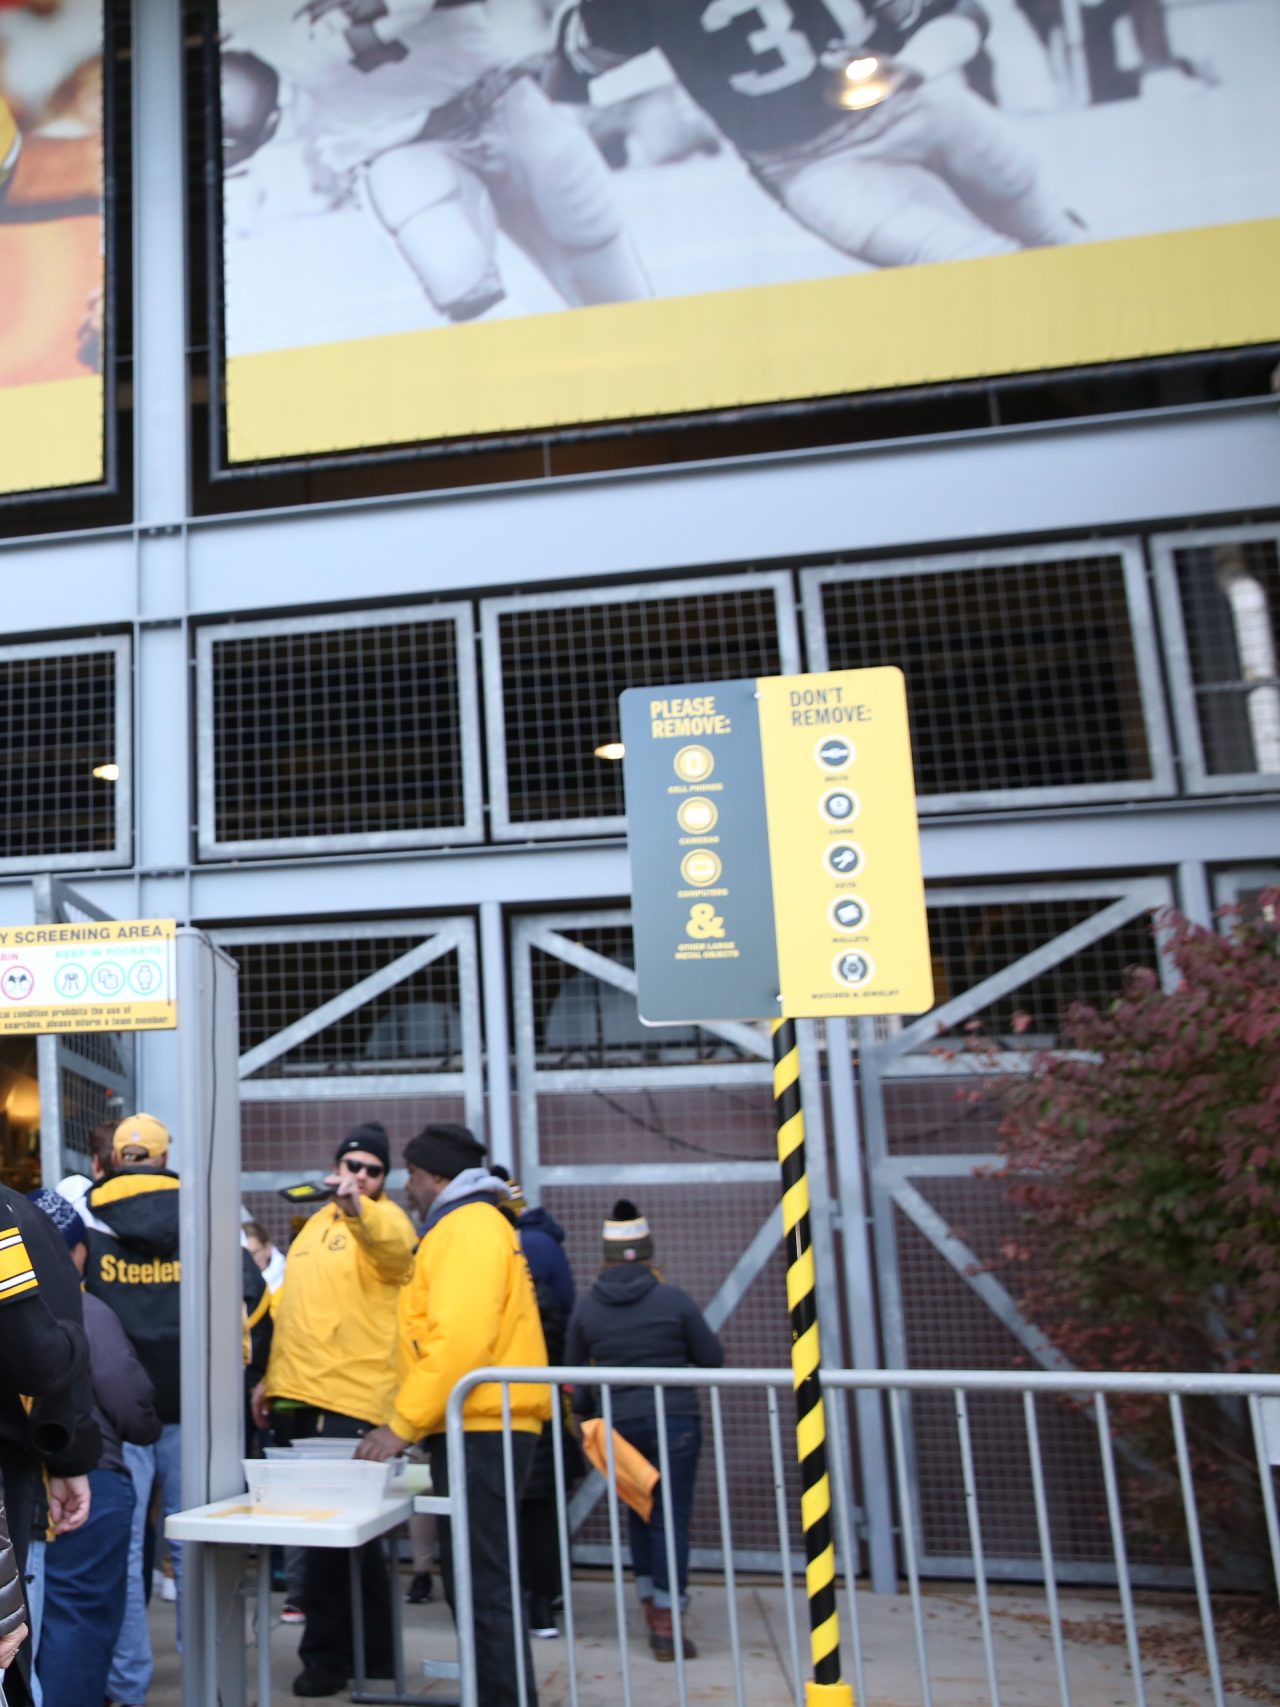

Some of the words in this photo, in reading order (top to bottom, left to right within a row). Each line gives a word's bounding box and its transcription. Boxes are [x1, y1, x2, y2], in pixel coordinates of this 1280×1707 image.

[649, 696, 716, 719] PLEASE
[790, 687, 843, 707] DON'T
[791, 705, 872, 726] REMOVE:
[651, 715, 732, 739] REMOVE:
[686, 902, 726, 939] &
[14, 928, 110, 944] SCREENING
[117, 925, 162, 939] AREA
[0, 952, 19, 962] BIN
[100, 1254, 181, 1284] Steeler
